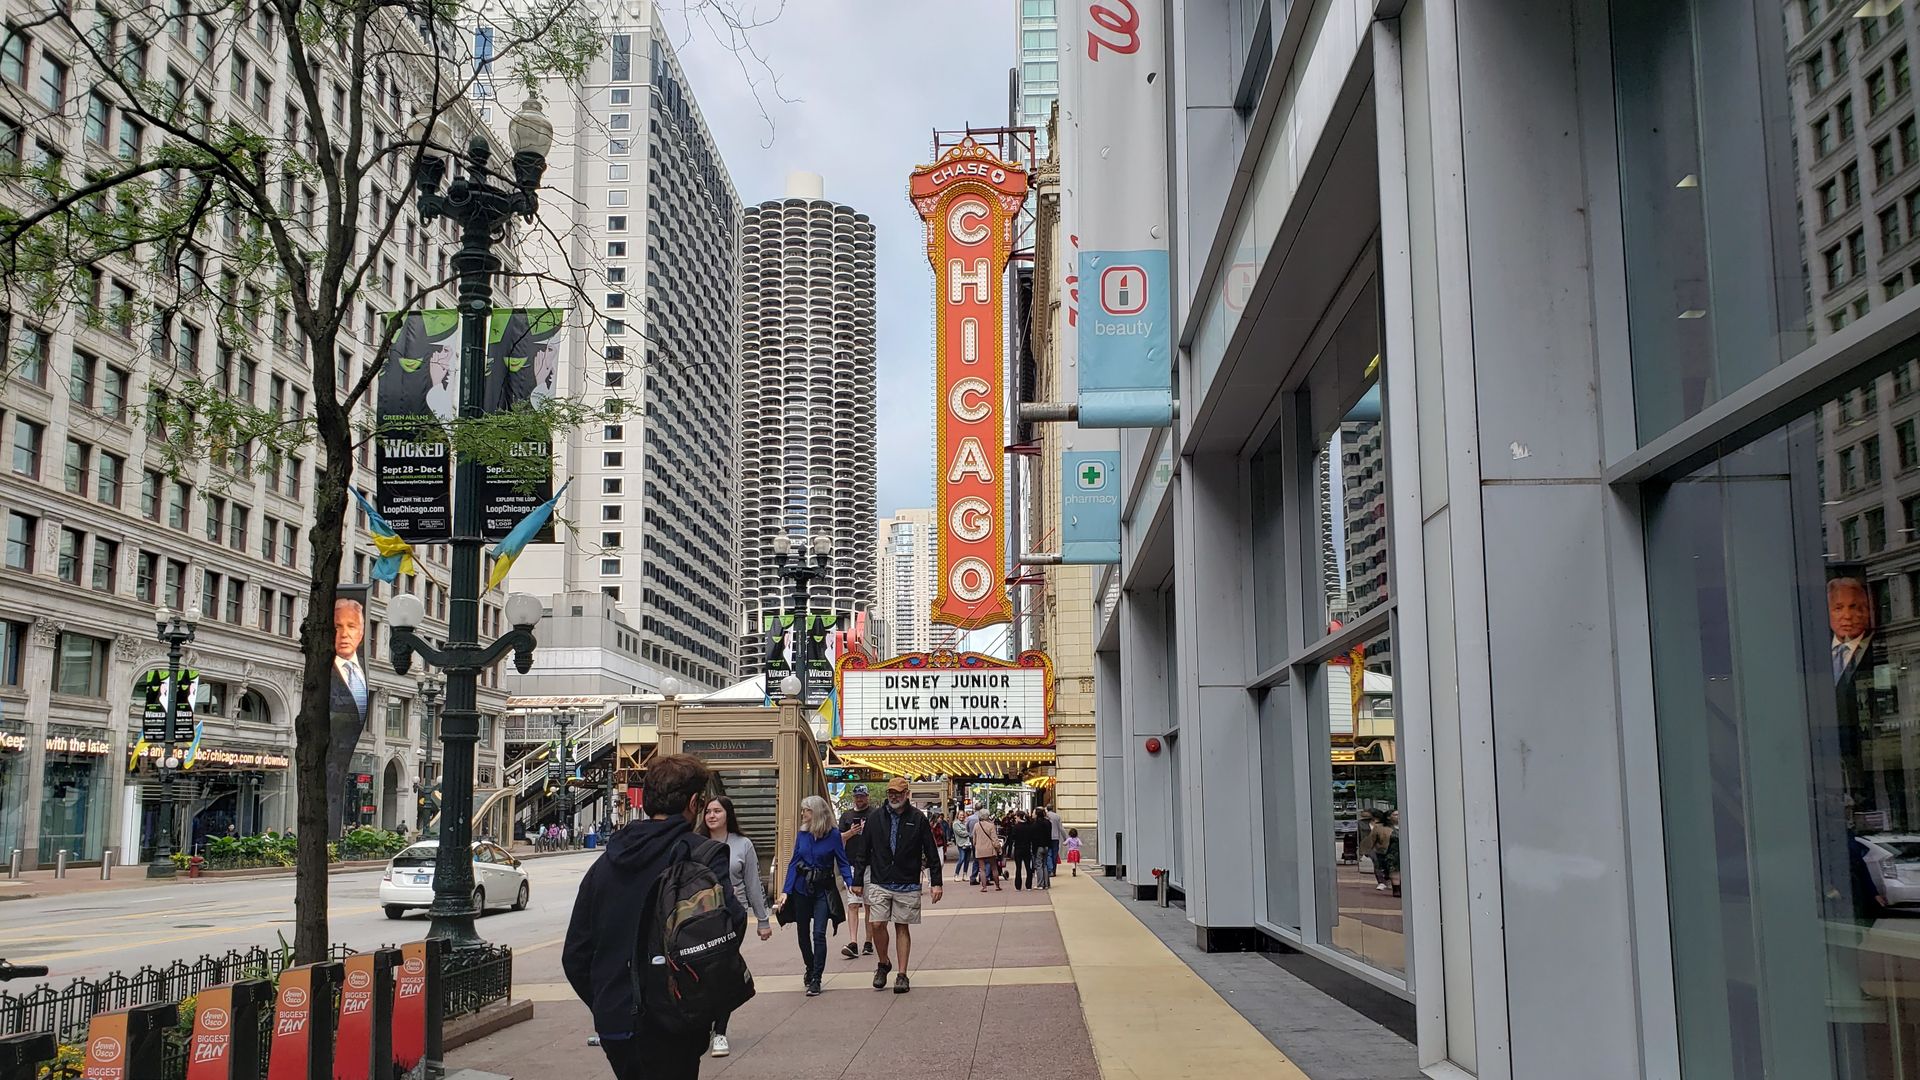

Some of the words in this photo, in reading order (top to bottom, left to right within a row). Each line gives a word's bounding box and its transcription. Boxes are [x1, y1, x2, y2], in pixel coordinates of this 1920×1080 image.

[931, 163, 990, 185] CHASE
[1095, 320, 1153, 338] beauty
[947, 199, 994, 605] CHICAGO
[382, 439, 445, 458] WICKED
[382, 466, 402, 475] Sept
[403, 466, 414, 474] 28
[420, 466, 437, 474] Dec
[437, 465, 444, 474] 4
[1064, 494, 1118, 506] pharmacy
[383, 505, 445, 514] LoopChicago.com
[768, 669, 790, 678] WICKED
[808, 669, 833, 678] WICKED
[885, 674, 941, 689] DISNEY
[950, 674, 1011, 689] JUNIOR
[886, 696, 920, 710] LIVE
[929, 696, 950, 709] ON
[960, 695, 1008, 709] TOUR:
[870, 716, 940, 731] COSTUME
[949, 716, 1023, 730] PALOOZA
[45, 736, 68, 751] with
[69, 738, 86, 752] the
[710, 741, 747, 750] SUBWAY
[680, 943, 707, 956] HERSCHEL
[706, 935, 727, 948] SUPPLY
[345, 991, 371, 999] BIGGEST
[400, 983, 424, 995] FAN
[343, 998, 370, 1012] FAN
[204, 1011, 224, 1019] Jewel
[279, 1010, 307, 1019] BIGGEST
[204, 1018, 223, 1026] Osco
[278, 1018, 307, 1033] FAN
[197, 1034, 230, 1043] BIGGEST
[95, 1041, 116, 1050] Jewel
[95, 1050, 114, 1058] Osco
[195, 1043, 229, 1061] FAN
[87, 1067, 122, 1077] BIGGEST
